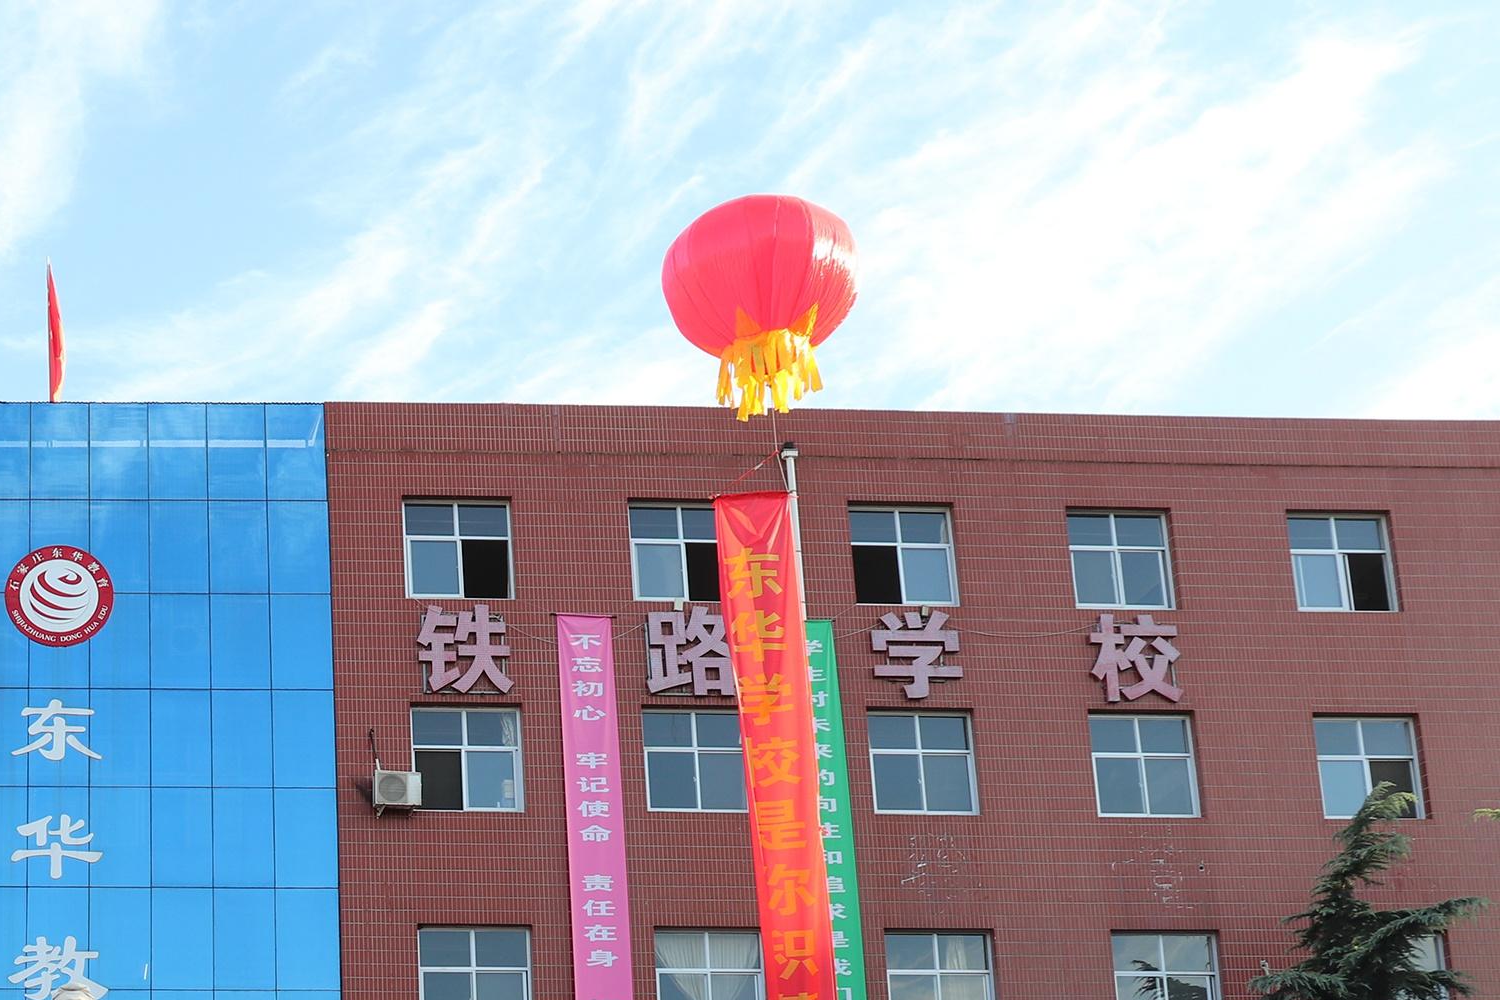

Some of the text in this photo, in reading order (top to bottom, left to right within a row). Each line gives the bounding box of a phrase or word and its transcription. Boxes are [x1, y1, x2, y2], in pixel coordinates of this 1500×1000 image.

[11, 605, 109, 642] SHIJIAZHUANG DONG HUA EDU
[570, 634, 606, 722] 不忘初心
[575, 753, 612, 843] 牢记使命
[581, 873, 619, 968] 责任在身
